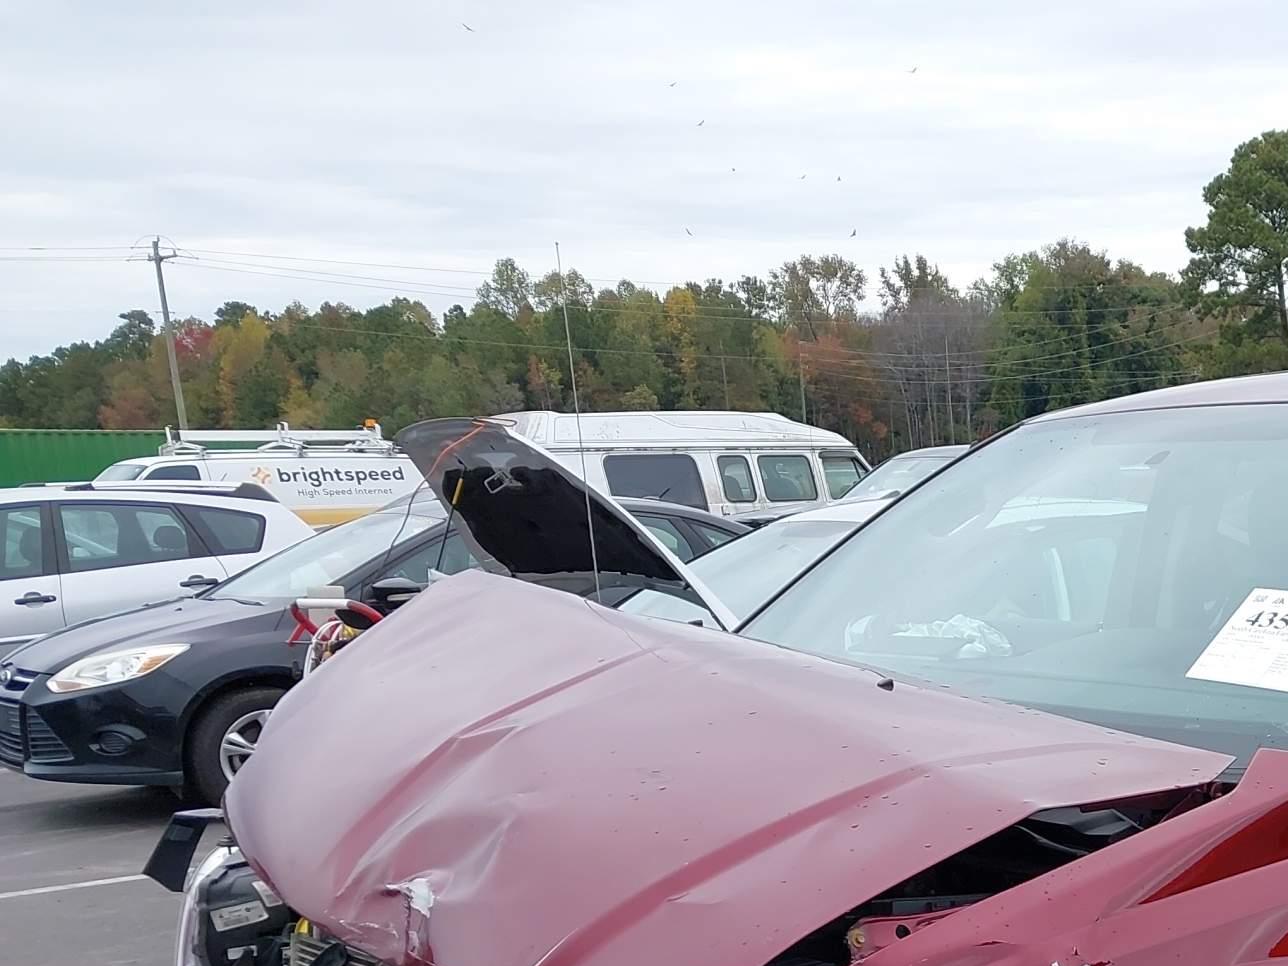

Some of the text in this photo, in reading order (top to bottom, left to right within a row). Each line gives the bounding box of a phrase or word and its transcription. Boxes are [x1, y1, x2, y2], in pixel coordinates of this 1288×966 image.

[276, 467, 405, 487] brightspeed
[297, 486, 393, 498] High Speed Internet
